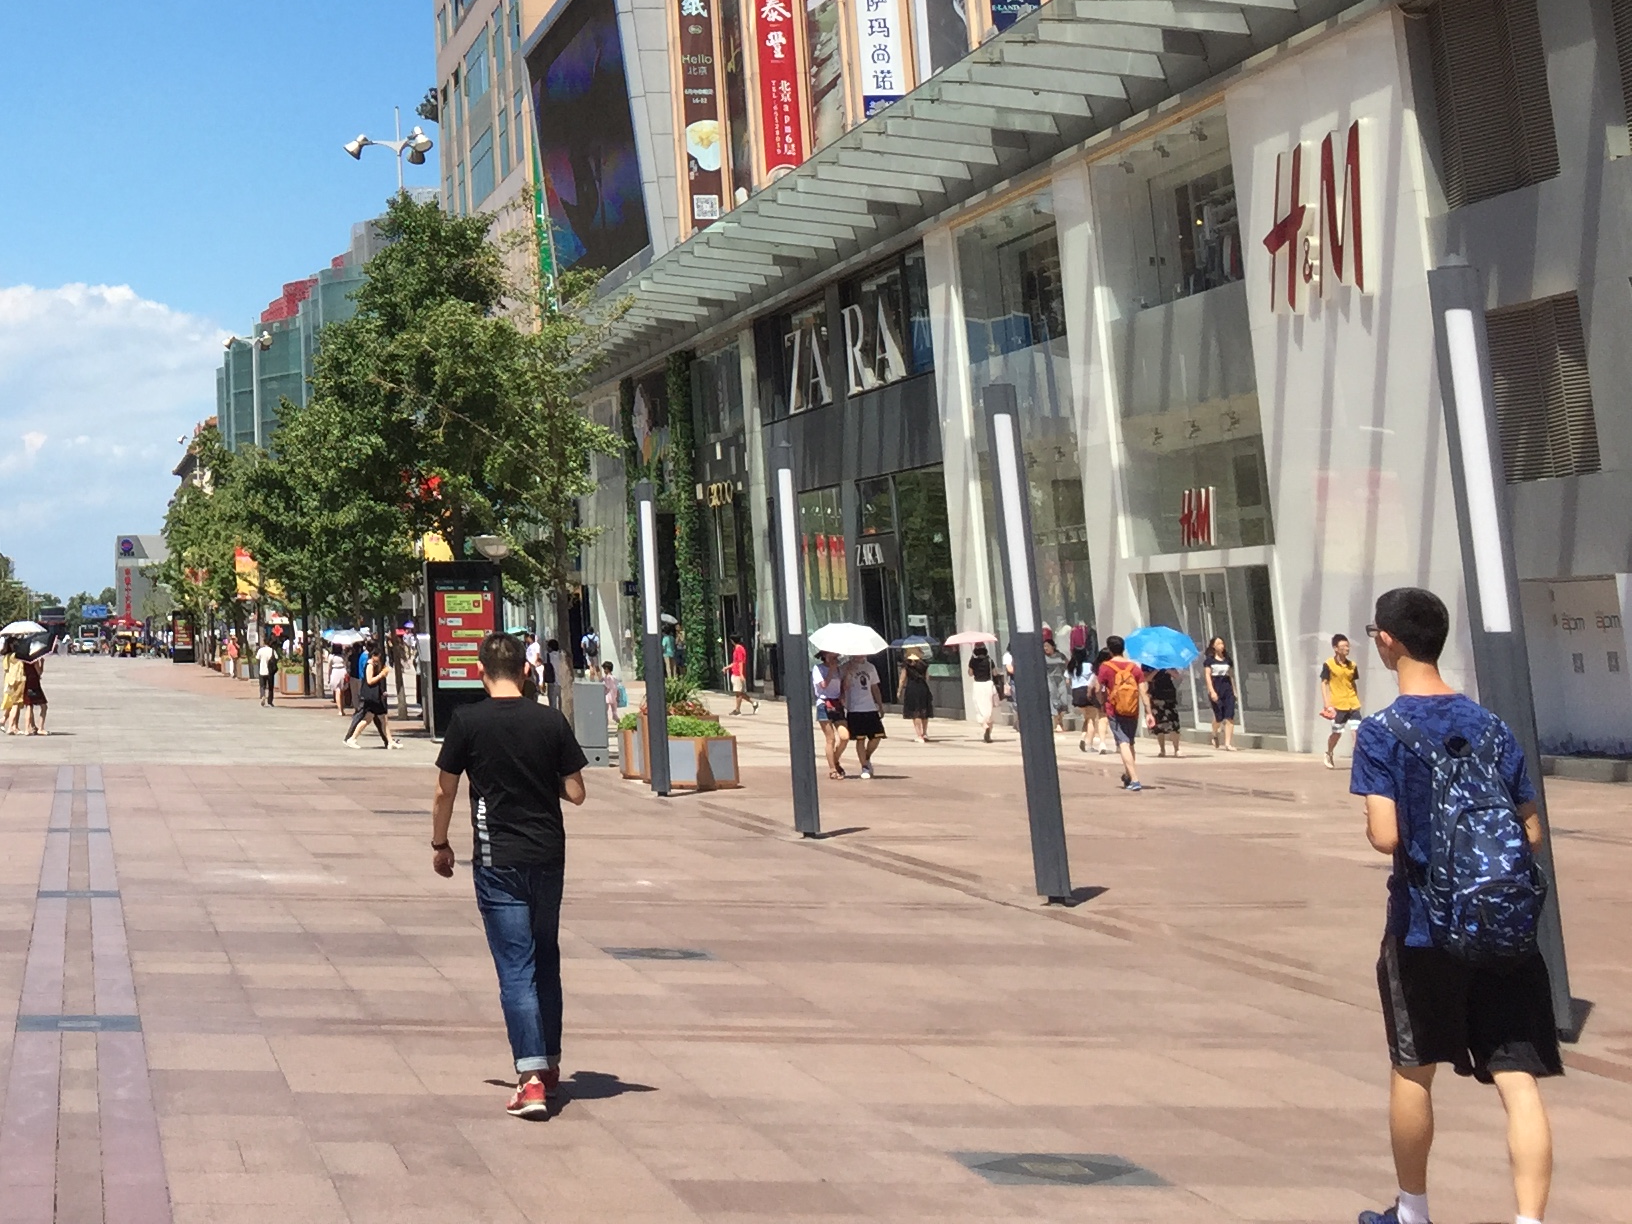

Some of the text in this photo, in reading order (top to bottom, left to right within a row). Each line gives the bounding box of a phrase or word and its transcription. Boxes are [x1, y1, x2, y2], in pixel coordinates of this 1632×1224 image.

[682, 54, 713, 65] Hello
[1263, 119, 1364, 313] H&M
[784, 295, 907, 415] ZARA
[1179, 486, 1214, 548] H&M
[855, 542, 885, 567] ZARA
[1561, 617, 1586, 635] apm
[1595, 614, 1621, 634] apm
